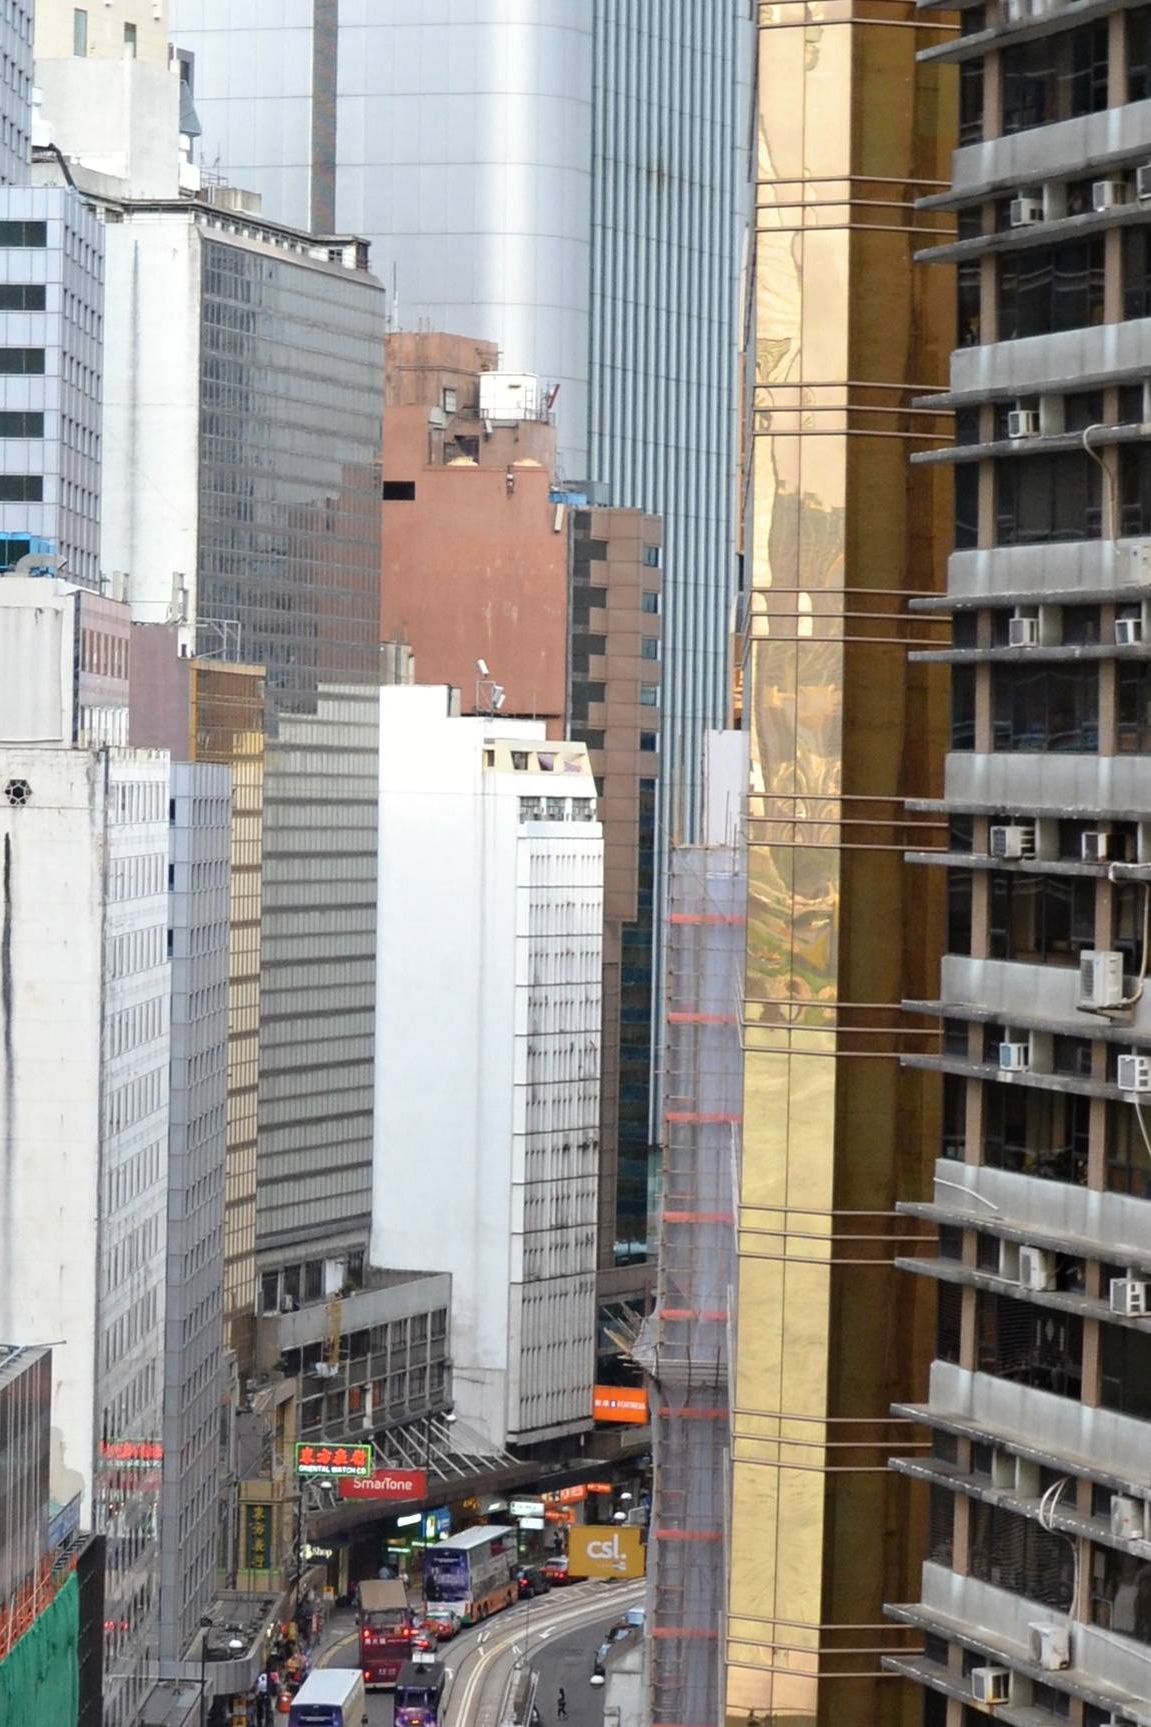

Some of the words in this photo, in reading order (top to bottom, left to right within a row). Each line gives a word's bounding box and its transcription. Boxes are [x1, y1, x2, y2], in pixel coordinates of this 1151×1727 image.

[299, 1465, 330, 1474] ORIENTAL
[331, 1466, 356, 1474] WATCH
[353, 1478, 413, 1491] SmarTone
[587, 1533, 627, 1559] csl.
